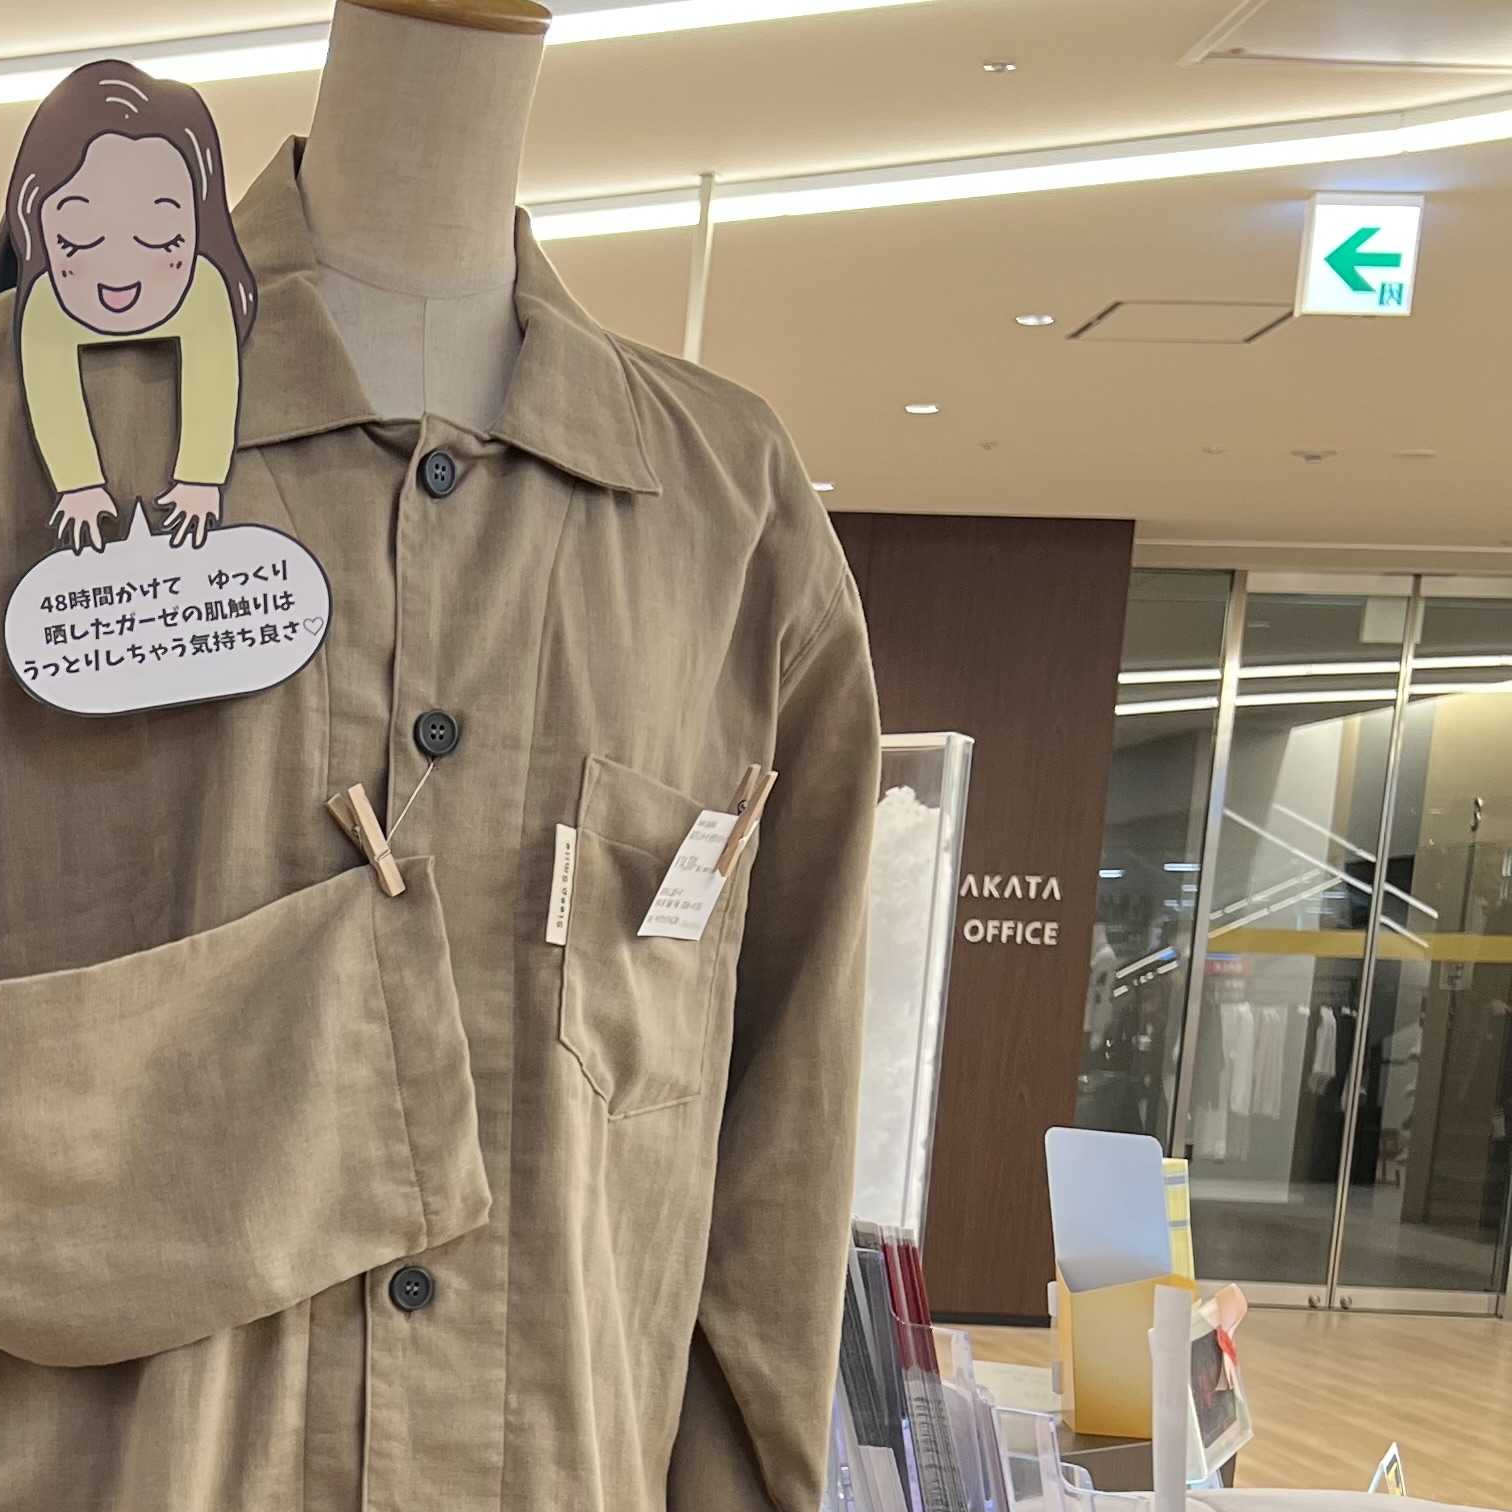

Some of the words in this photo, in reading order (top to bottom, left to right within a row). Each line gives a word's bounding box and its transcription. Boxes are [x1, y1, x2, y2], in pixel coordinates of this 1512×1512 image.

[40, 576, 183, 614] 48時間かけて
[207, 559, 289, 590] ゆっくり
[44, 590, 296, 646] 晒したガーゼの肌触りは
[963, 918, 1060, 946] OFFICE
